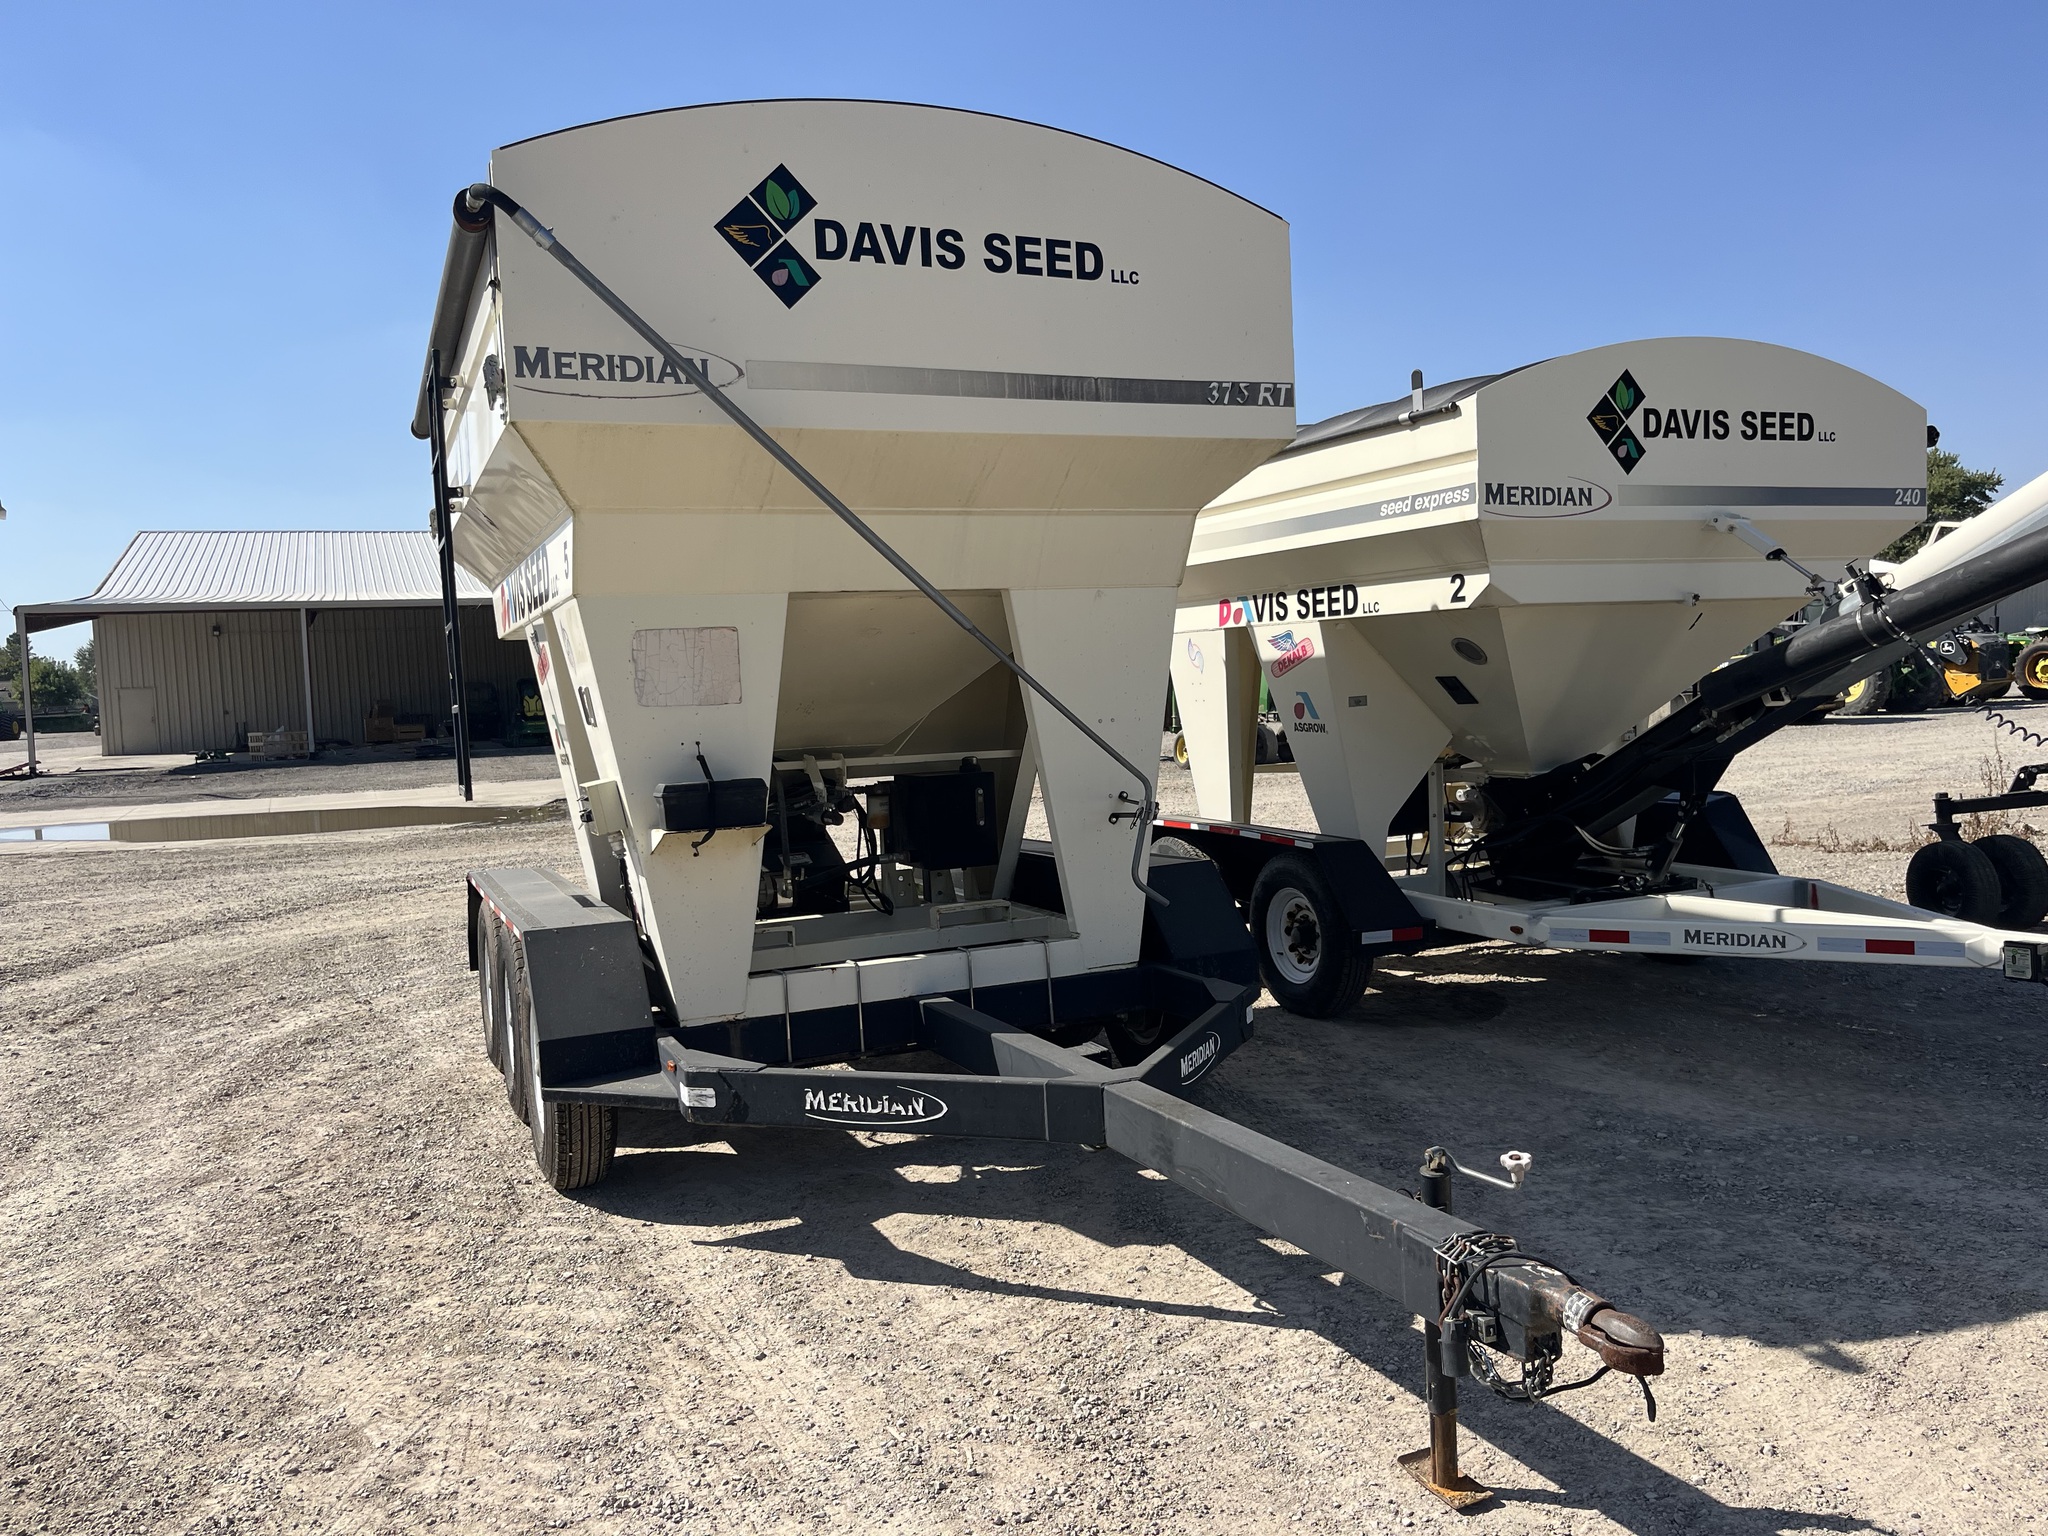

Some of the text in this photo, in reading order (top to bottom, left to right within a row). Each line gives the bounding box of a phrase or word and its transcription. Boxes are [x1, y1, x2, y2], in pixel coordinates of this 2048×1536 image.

[813, 218, 1140, 285] DAVIS SEED LLC
[512, 345, 709, 385] MERIDIAN
[1207, 381, 1292, 406] 375 RT
[1642, 407, 1836, 443] DAVIS SEED LLC
[1379, 486, 1471, 517] seed express
[1483, 482, 1593, 507] MERIDIAN
[1894, 488, 1921, 506] 240
[563, 540, 570, 580] 5
[524, 543, 550, 614] SEED
[1449, 573, 1467, 604] 2
[1296, 584, 1359, 620] SEED
[1362, 601, 1380, 614] LLC
[1277, 644, 1309, 673] DEKALB
[1293, 722, 1327, 734] ASGROW
[1683, 928, 1787, 949] MERIDIAN
[1180, 1036, 1215, 1078] MERIDIAN
[803, 1088, 925, 1117] MERIDIAN
